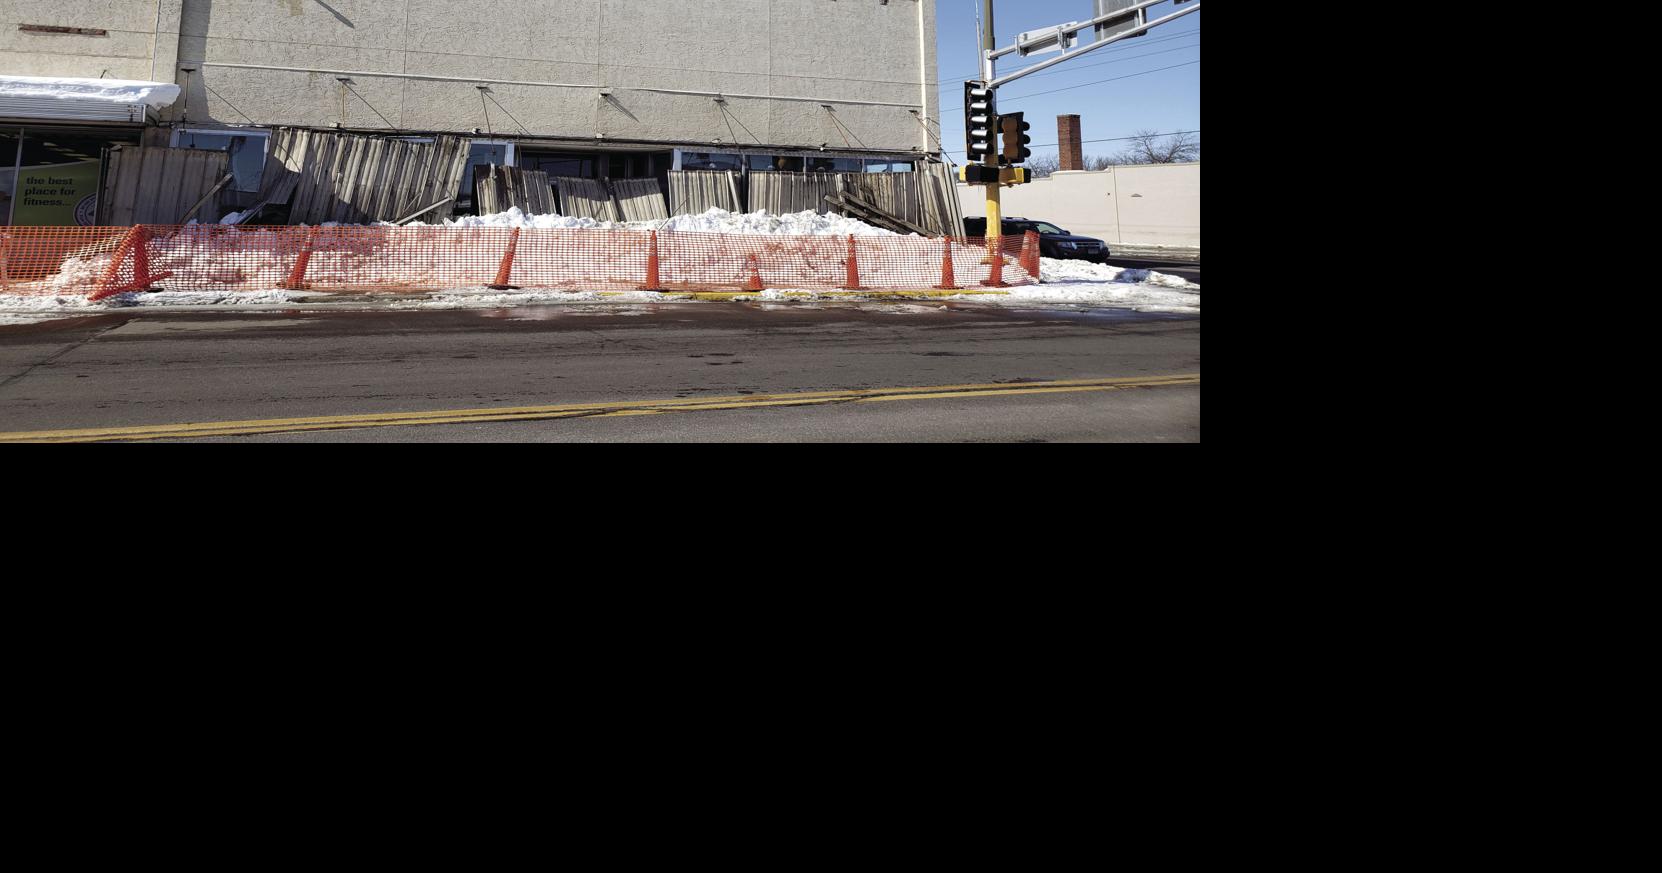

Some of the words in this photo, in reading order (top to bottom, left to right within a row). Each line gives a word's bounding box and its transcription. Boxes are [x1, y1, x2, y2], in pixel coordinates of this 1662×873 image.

[26, 176, 45, 185] the
[48, 176, 73, 185] best
[24, 187, 57, 196] place
[60, 187, 76, 195] for
